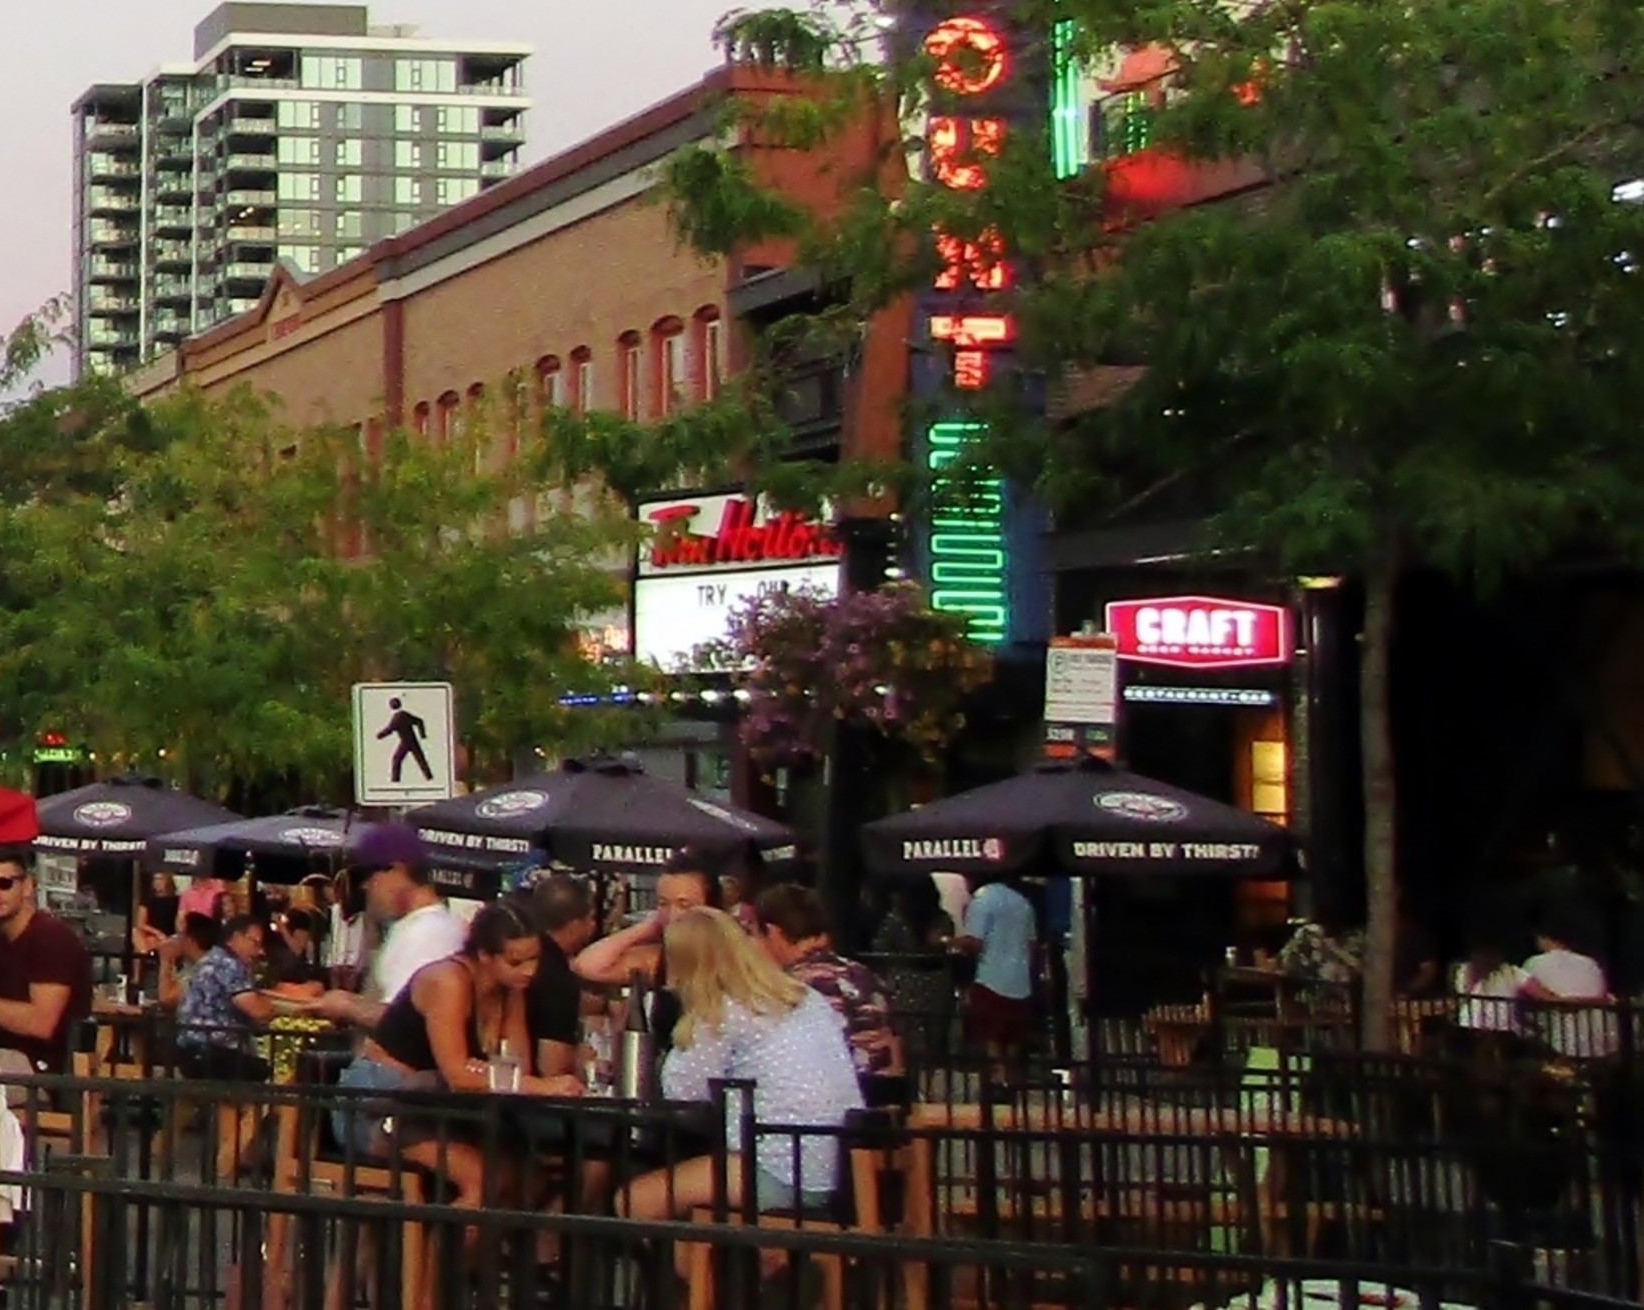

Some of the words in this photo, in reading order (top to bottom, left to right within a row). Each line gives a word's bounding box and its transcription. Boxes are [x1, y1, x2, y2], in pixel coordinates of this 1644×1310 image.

[697, 585, 727, 604] TRY
[1135, 607, 1256, 647] CRAFT
[466, 834, 484, 848] BY
[902, 840, 982, 860] PARALLEL
[1073, 842, 1146, 858] DRIVEN
[1149, 843, 1177, 858] BY
